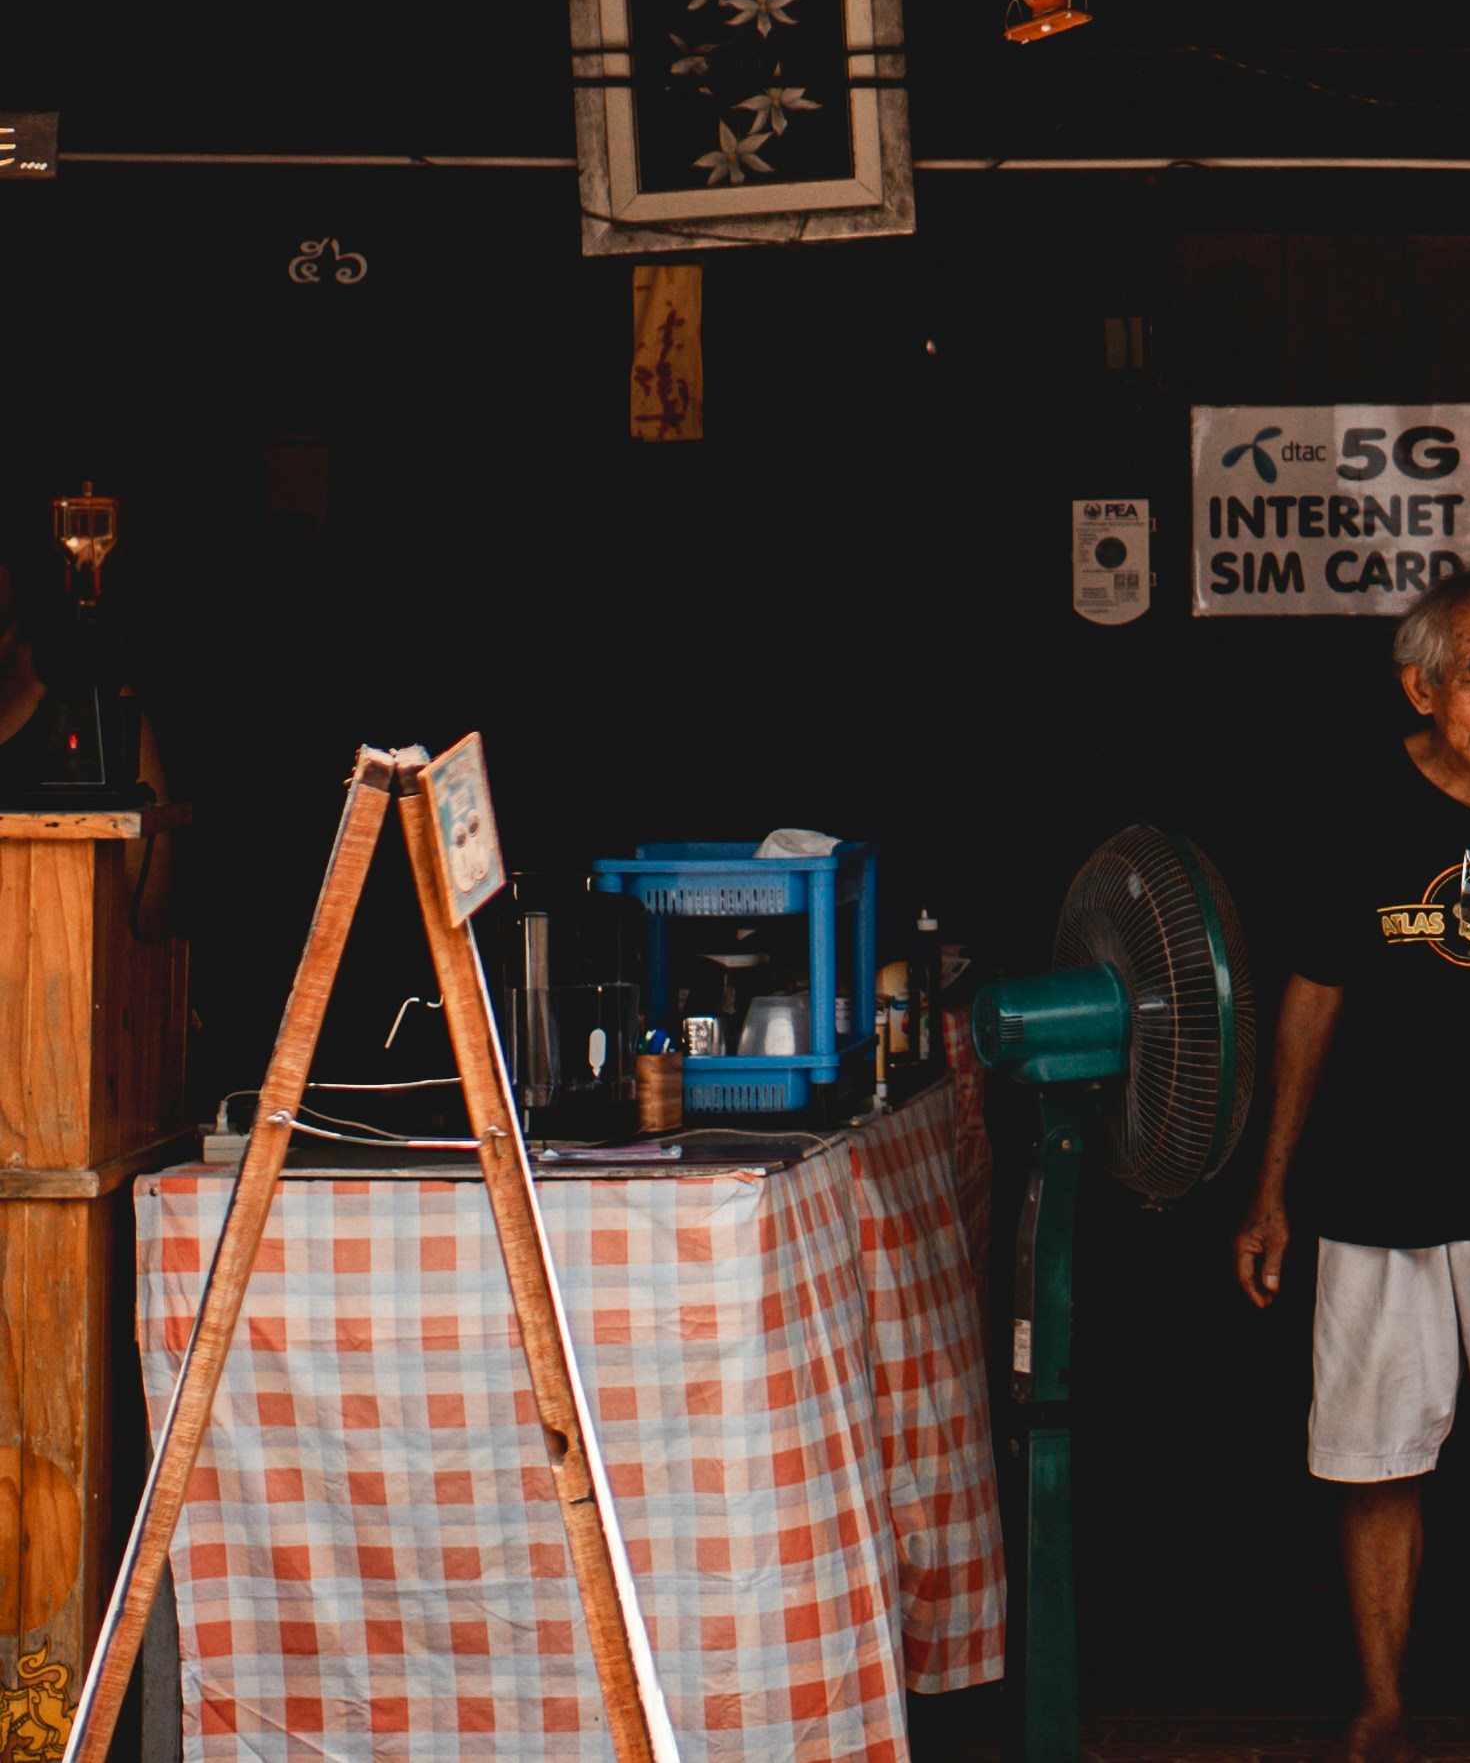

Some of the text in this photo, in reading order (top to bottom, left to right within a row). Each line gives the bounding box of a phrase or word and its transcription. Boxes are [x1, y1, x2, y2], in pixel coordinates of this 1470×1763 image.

[1281, 426, 1460, 481] dtac 5G
[1105, 503, 1138, 517] PEA
[1209, 494, 1465, 539] INTERNET
[1210, 550, 1465, 595] SIM CARD
[1381, 911, 1446, 937] ATLAS
